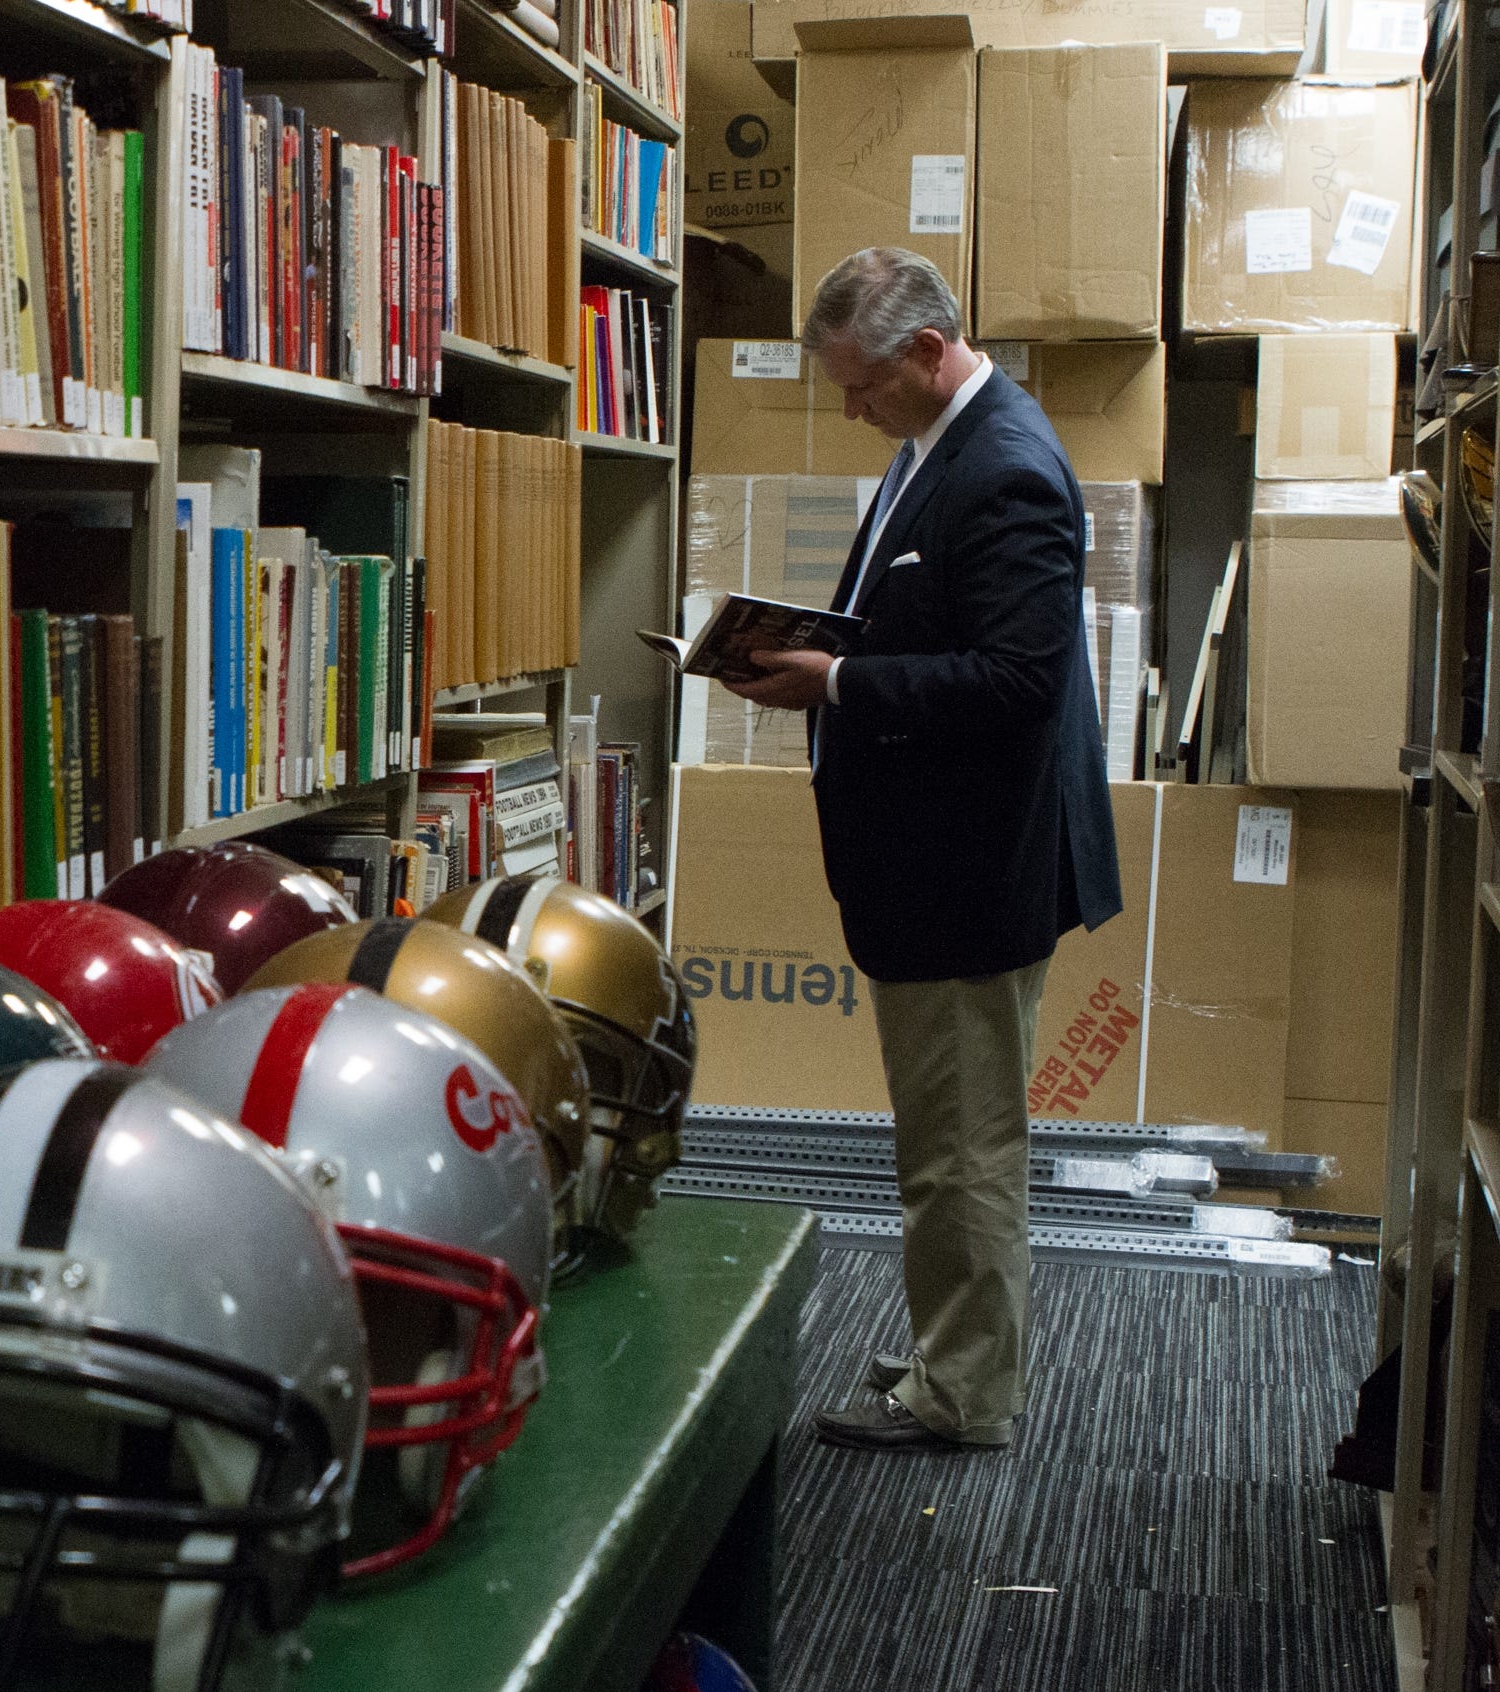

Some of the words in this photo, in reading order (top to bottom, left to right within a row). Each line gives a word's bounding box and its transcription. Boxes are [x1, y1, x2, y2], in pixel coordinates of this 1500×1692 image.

[495, 796, 523, 815] FOOTBALL
[681, 956, 858, 1017] tenns
[1088, 977, 1121, 1013] DO
[1045, 1003, 1141, 1116] METAL
[1058, 1010, 1098, 1060] NOT
